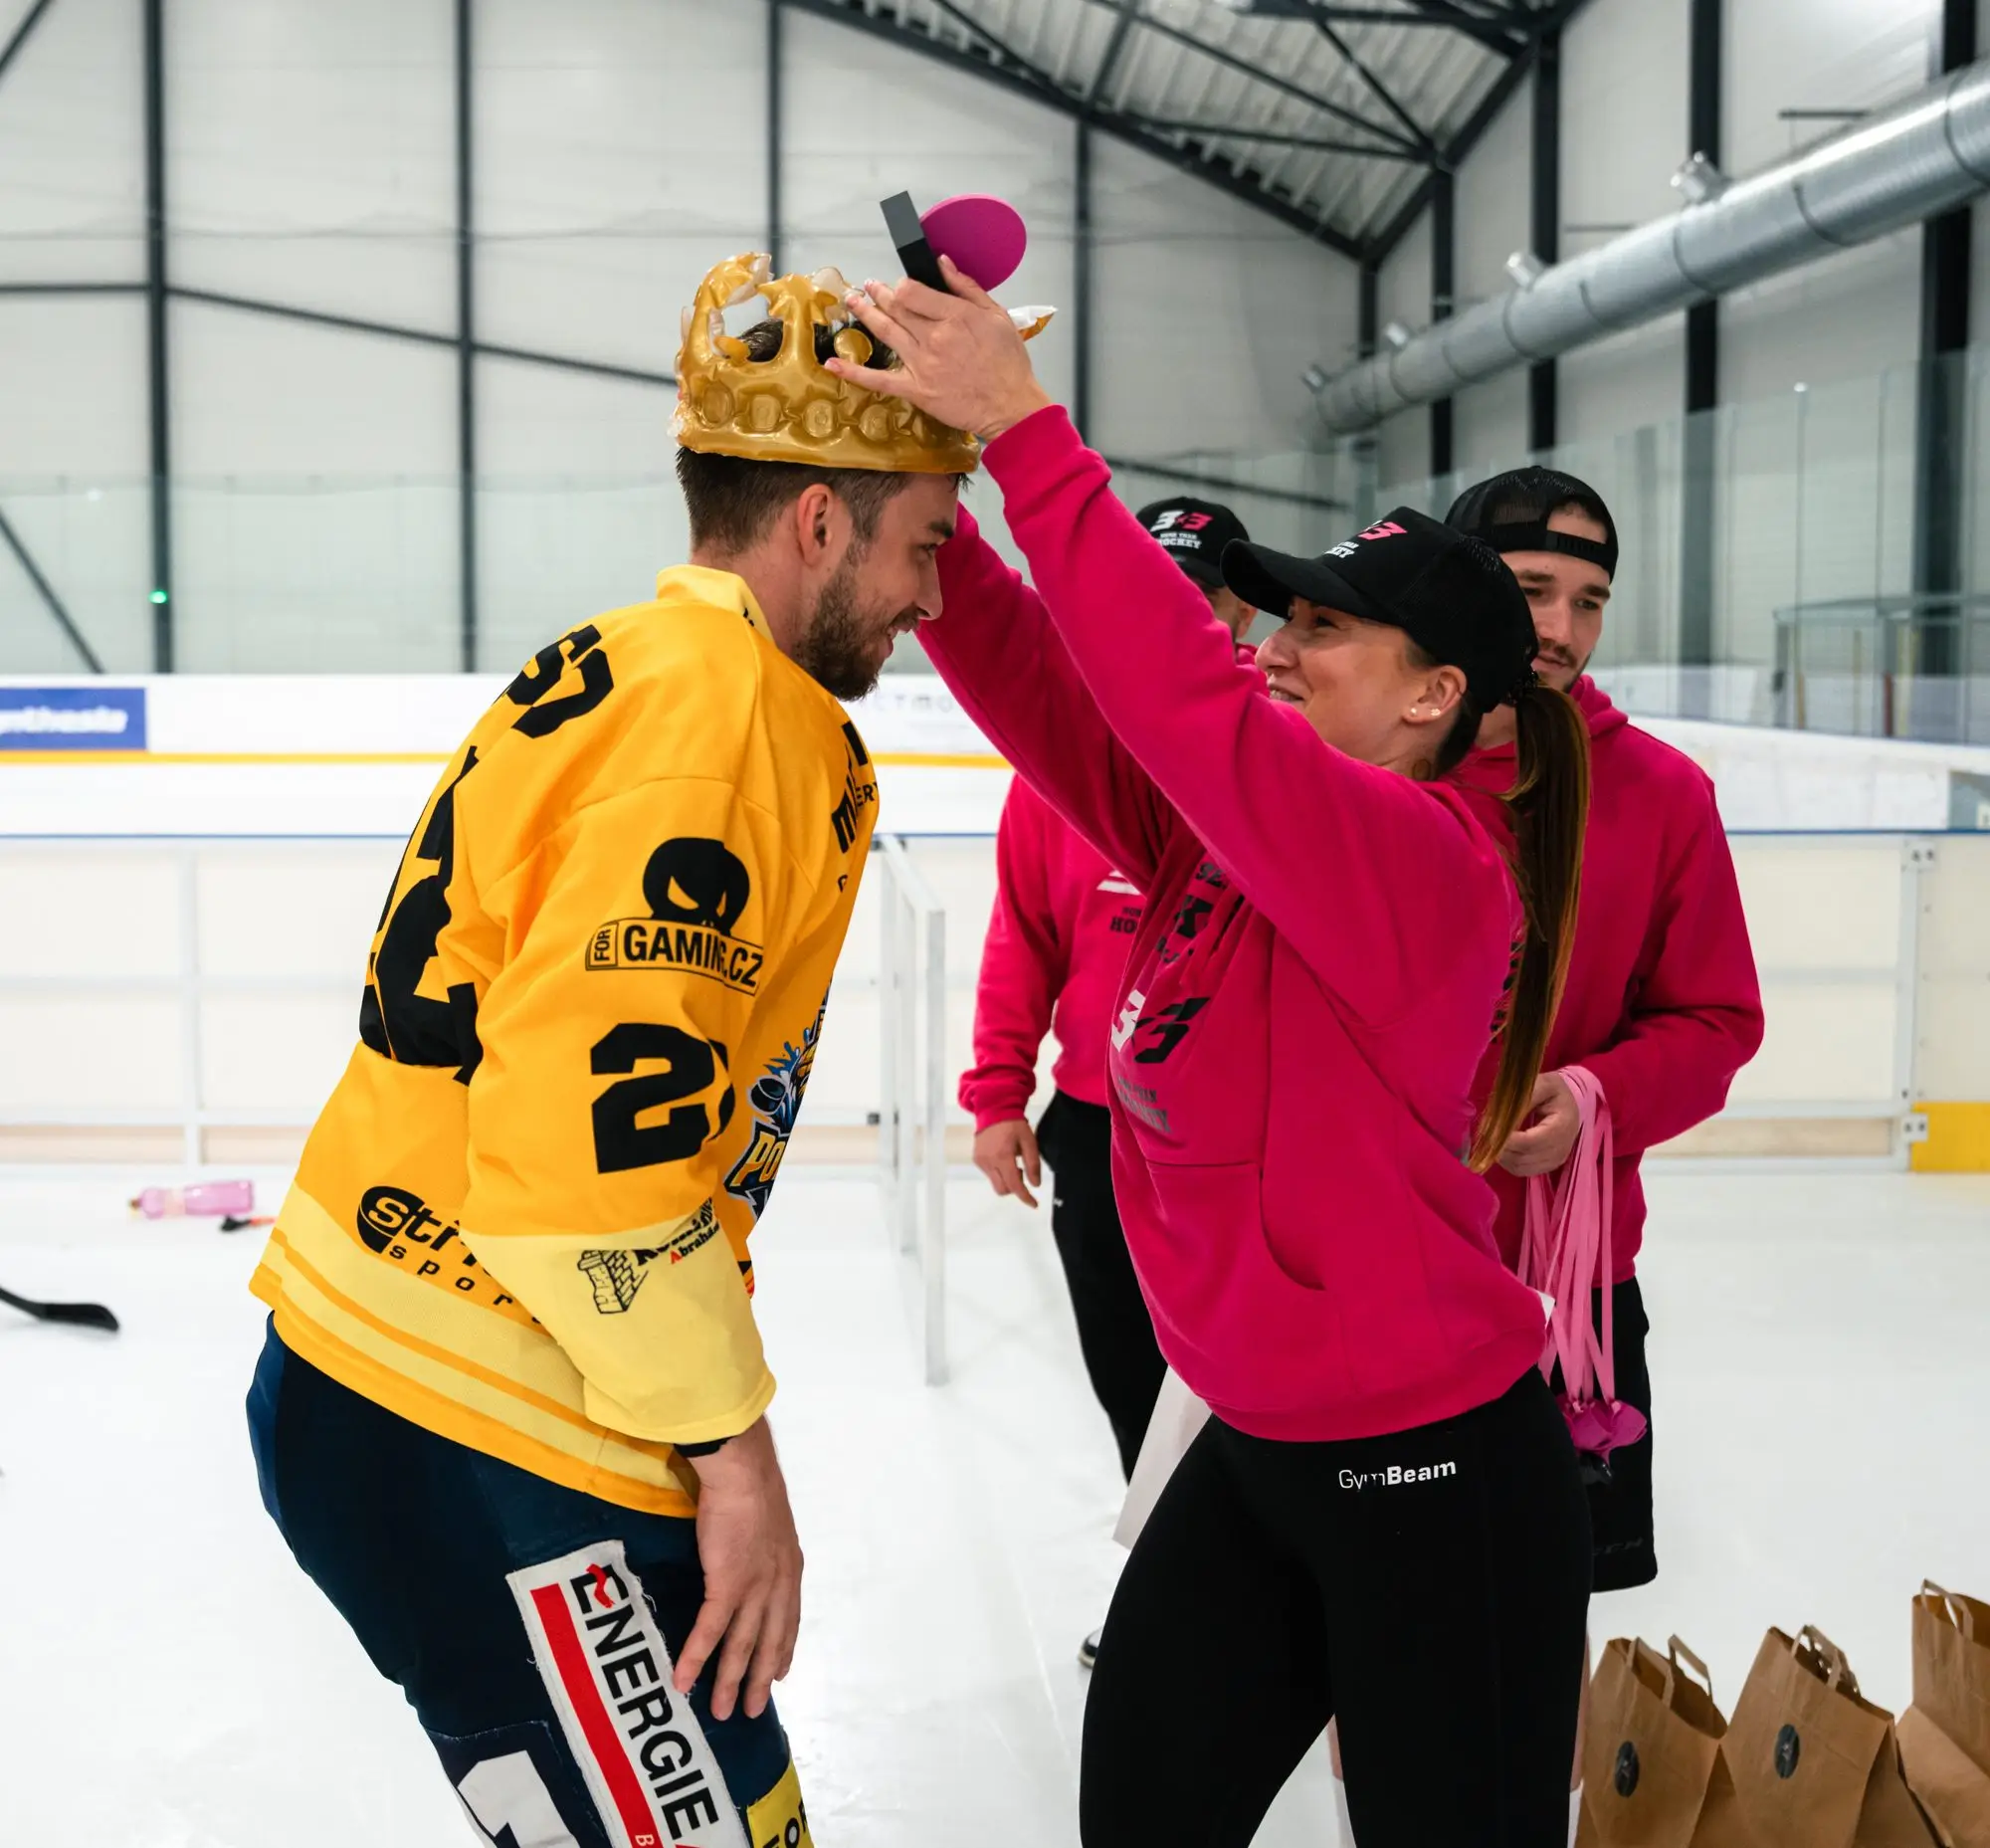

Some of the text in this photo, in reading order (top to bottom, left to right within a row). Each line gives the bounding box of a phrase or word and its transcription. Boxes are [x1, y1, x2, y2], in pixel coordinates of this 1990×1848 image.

[594, 928, 612, 961] FOR
[1338, 1460, 1457, 1493] GymBeam
[569, 1562, 720, 1841] ENERGIE
